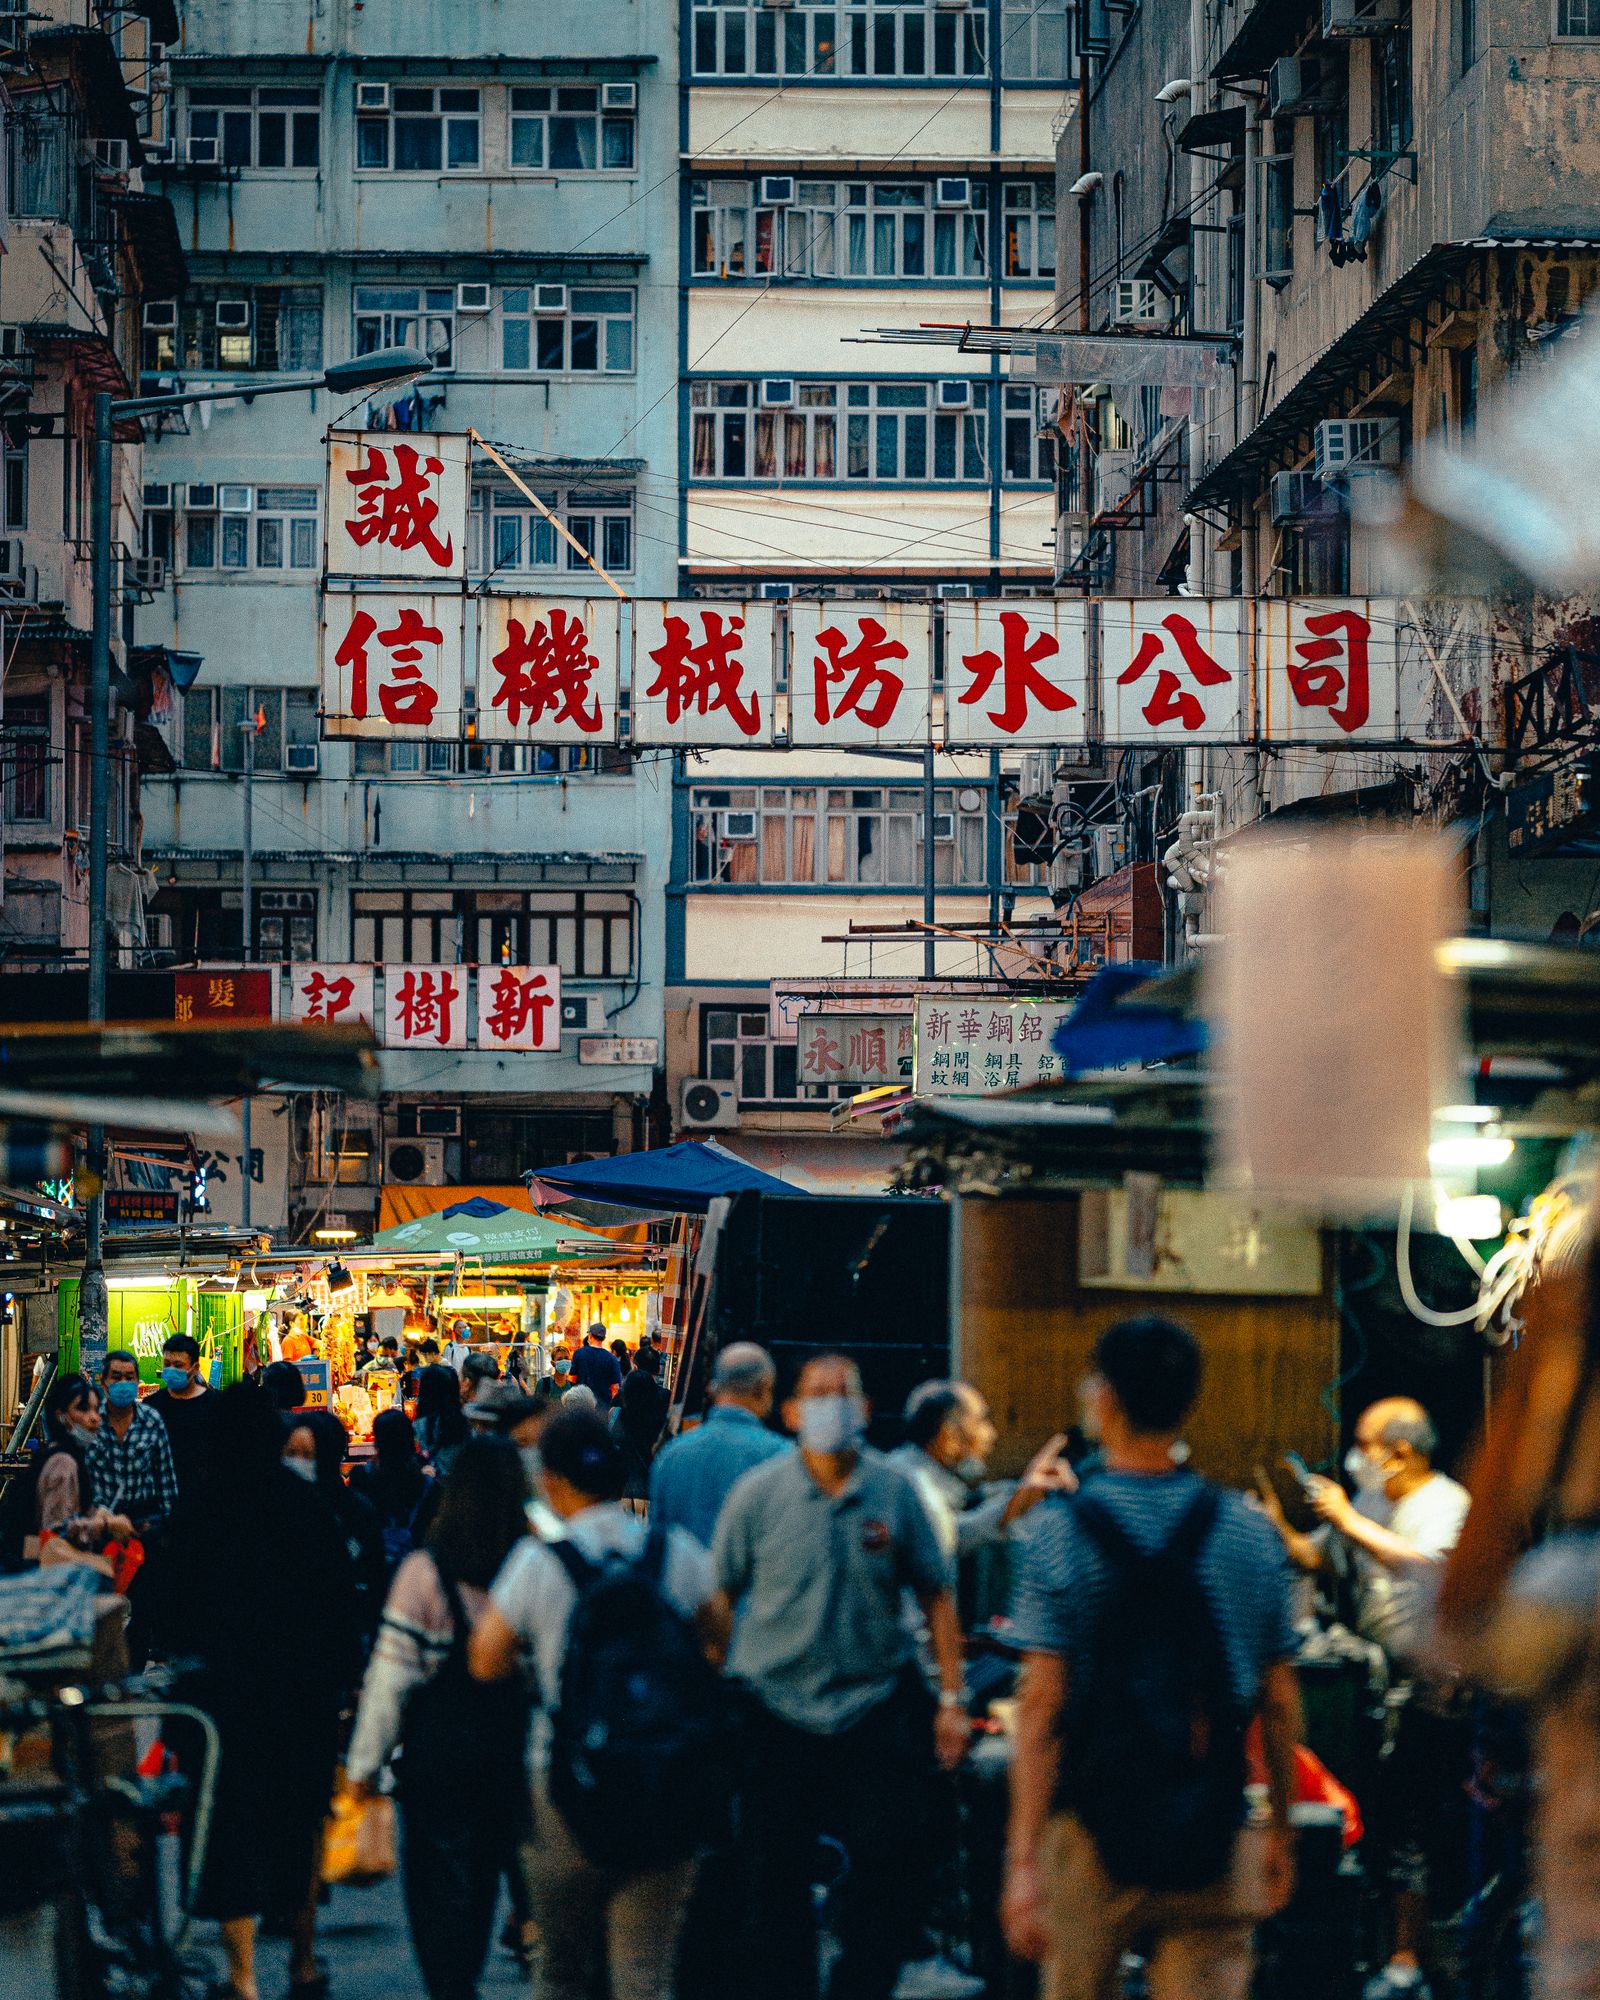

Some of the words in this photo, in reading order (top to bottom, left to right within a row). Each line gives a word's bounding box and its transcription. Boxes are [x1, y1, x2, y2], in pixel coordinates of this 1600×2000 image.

[344, 443, 454, 569] 誠
[334, 607, 1371, 736] 信機械防水公司
[803, 1026, 888, 1075] 永順
[932, 1051, 969, 1069] 鋼閘
[984, 1052, 1023, 1070] 鋼具
[931, 1070, 969, 1087] 蚊網
[984, 1071, 1021, 1089] 浴屏
[311, 1392, 322, 1403] 30
